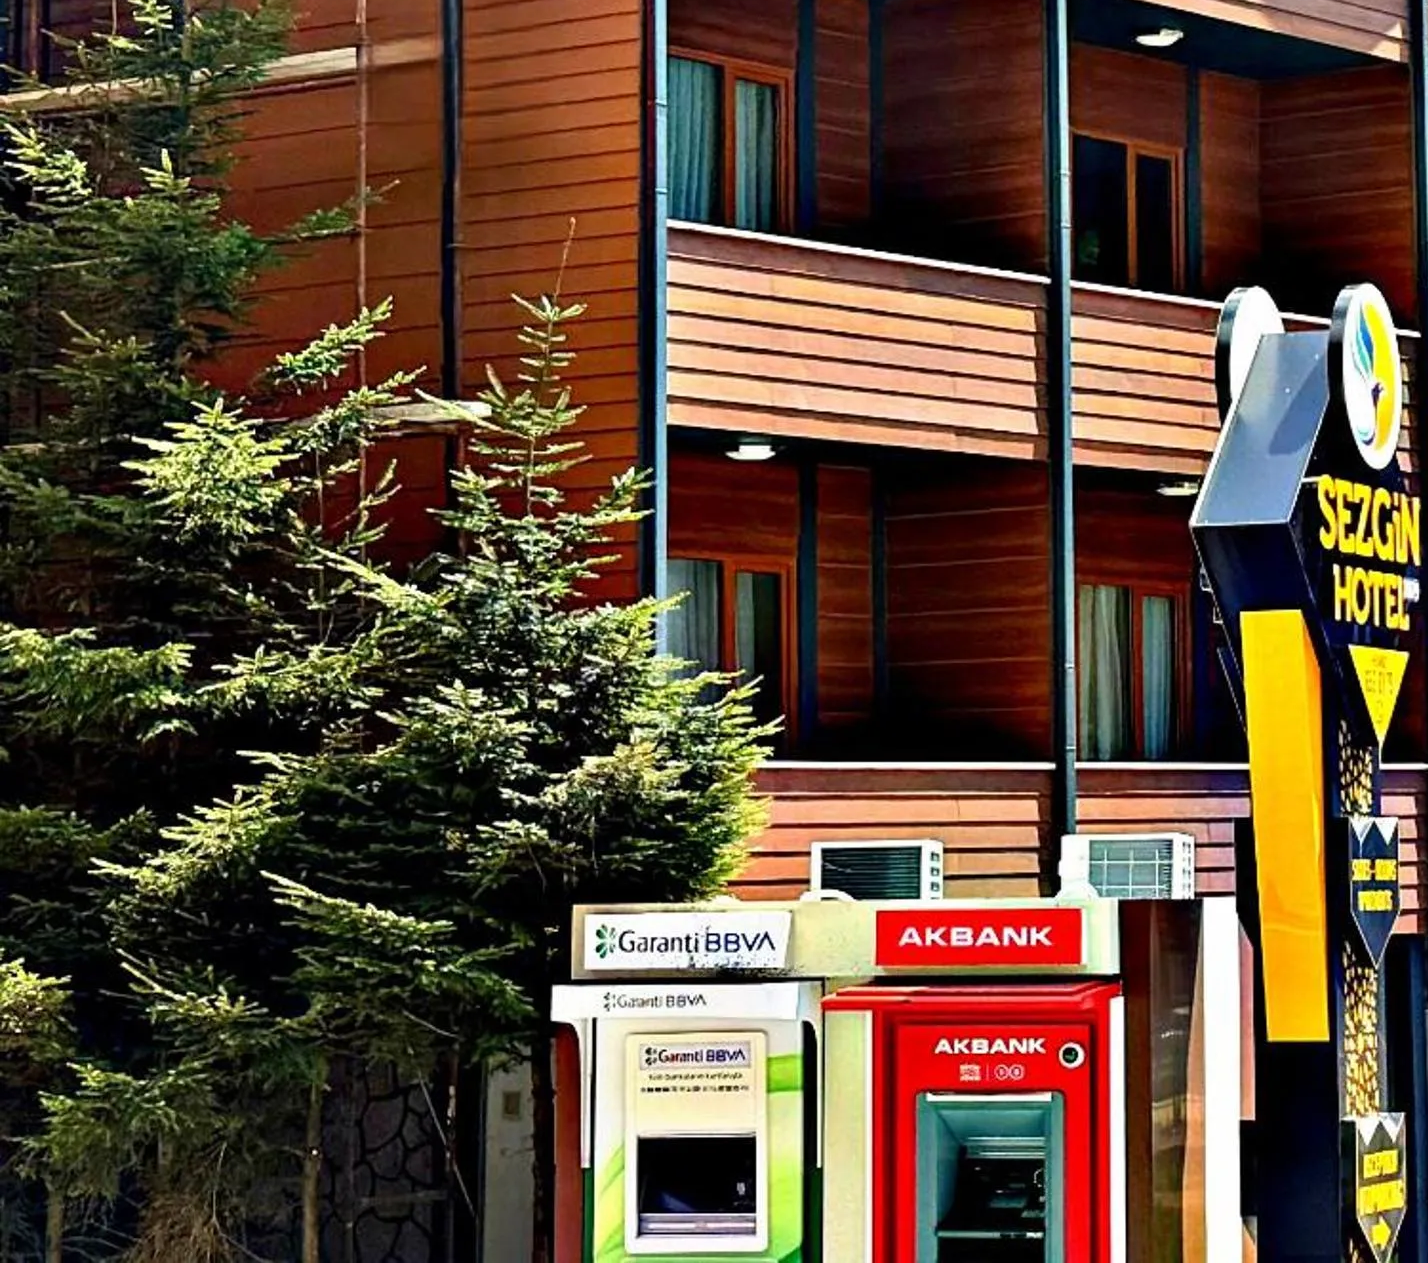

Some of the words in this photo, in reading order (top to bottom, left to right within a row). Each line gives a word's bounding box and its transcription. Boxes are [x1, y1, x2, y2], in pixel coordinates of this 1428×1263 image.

[1333, 563, 1411, 631] HOTEL
[618, 930, 699, 954] Garanti
[705, 931, 776, 953] BBVA
[898, 926, 1053, 947] AKBANK
[616, 993, 662, 1009] Garanti
[665, 994, 707, 1008] BBVA
[934, 1038, 1047, 1054] AKBANK
[658, 1048, 703, 1063] Garanti
[706, 1048, 746, 1063] BBVA
